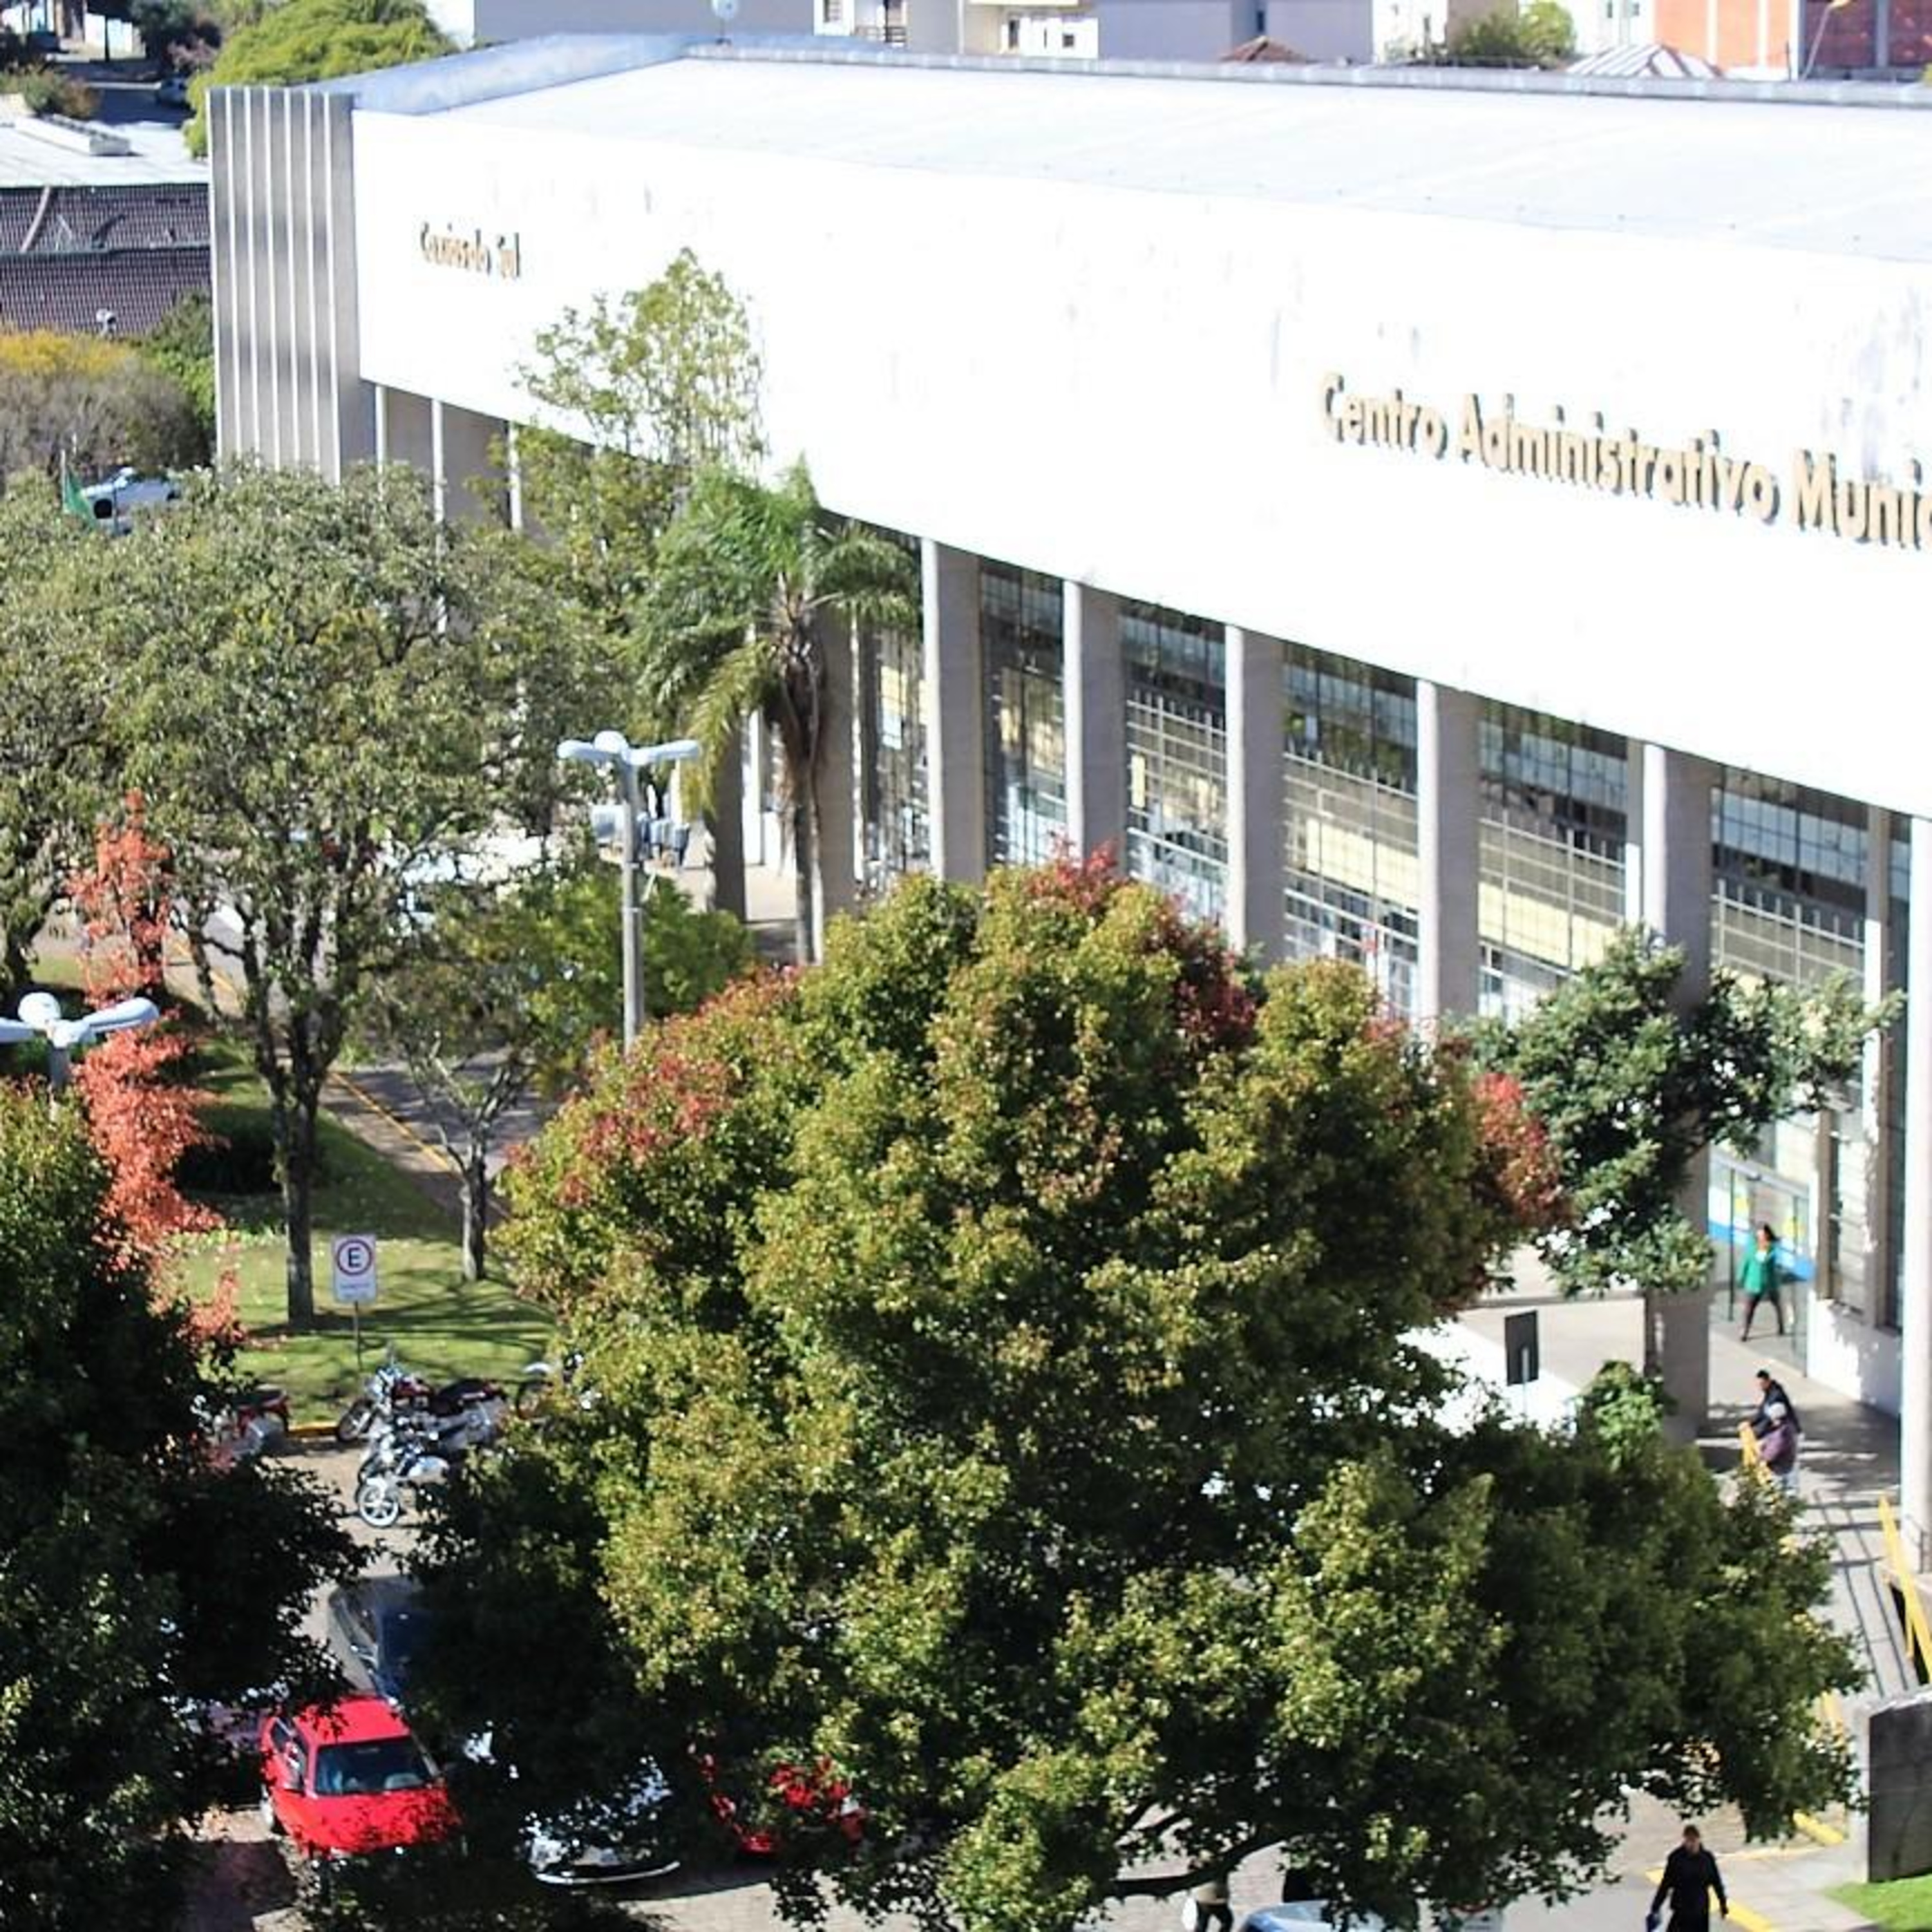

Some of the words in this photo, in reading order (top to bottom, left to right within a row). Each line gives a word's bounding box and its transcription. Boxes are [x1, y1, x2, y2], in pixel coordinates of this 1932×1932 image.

[1320, 372, 1448, 460] Centro
[1459, 392, 1781, 526] Administrativo
[348, 1247, 361, 1268] E
